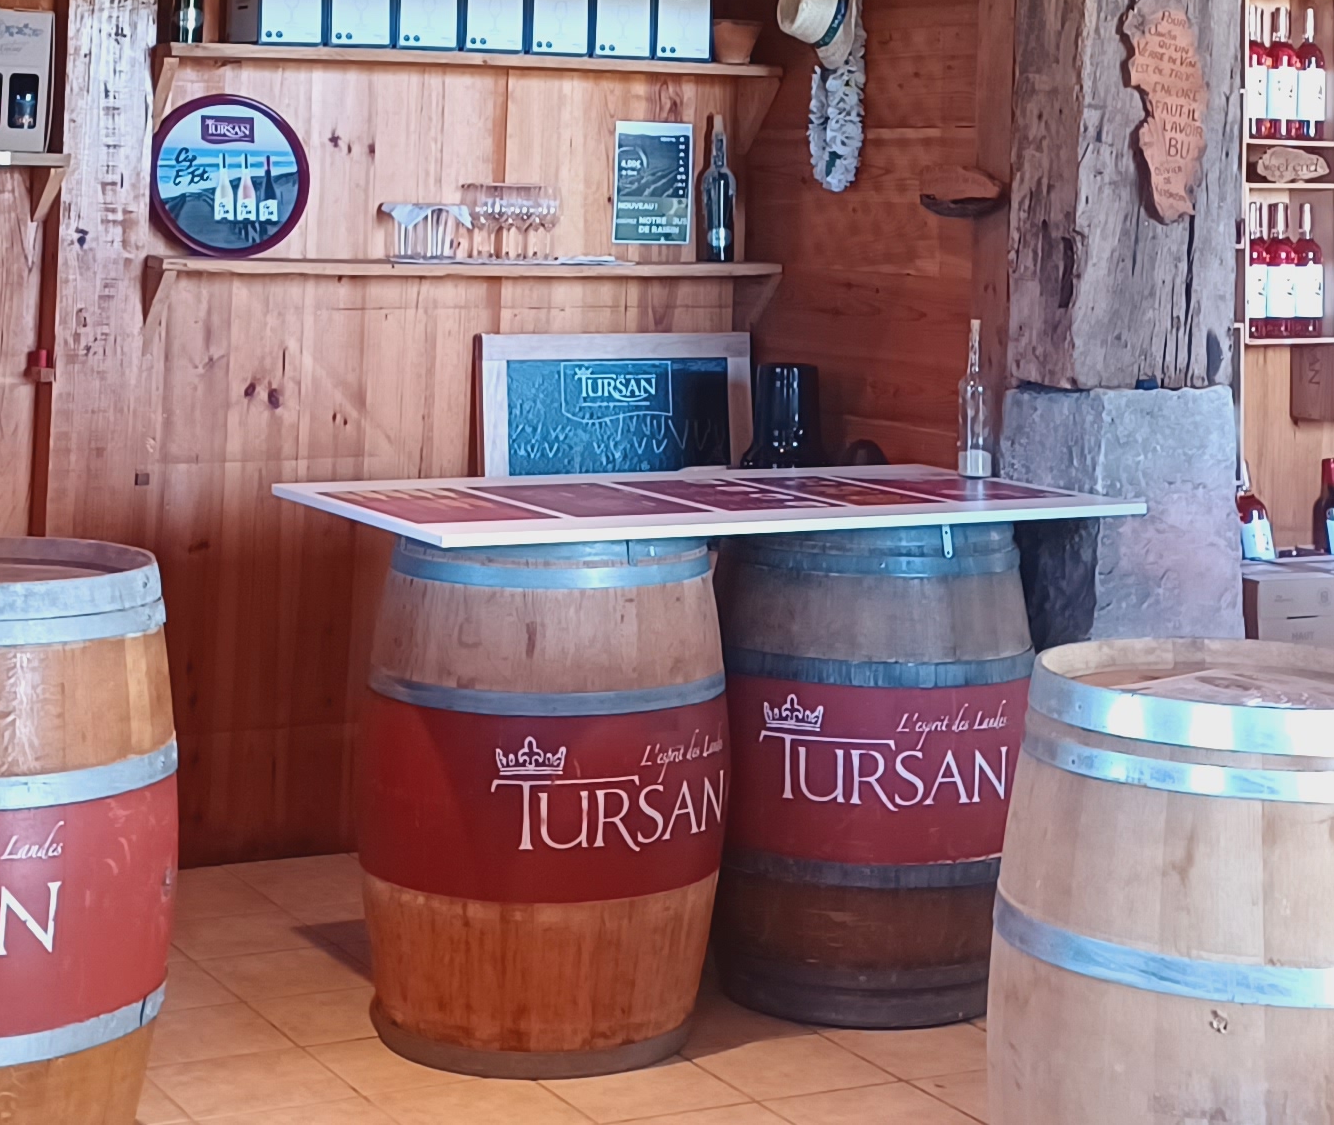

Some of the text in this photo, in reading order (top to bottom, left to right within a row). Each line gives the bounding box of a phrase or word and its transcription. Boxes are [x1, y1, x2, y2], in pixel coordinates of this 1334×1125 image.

[1180, 55, 1197, 68] VIN
[1152, 81, 1200, 103] ENCORE
[206, 120, 250, 139] TURSAN
[1167, 137, 1191, 160] BU
[638, 216, 668, 225] NOTRE
[638, 225, 650, 234] DE
[574, 374, 656, 401] TURSAN
[896, 712, 949, 750] L'esprit
[952, 703, 970, 733] des
[759, 730, 1009, 812] TURSAN
[491, 769, 725, 853] TURSAN
[0, 820, 65, 861] Landes
